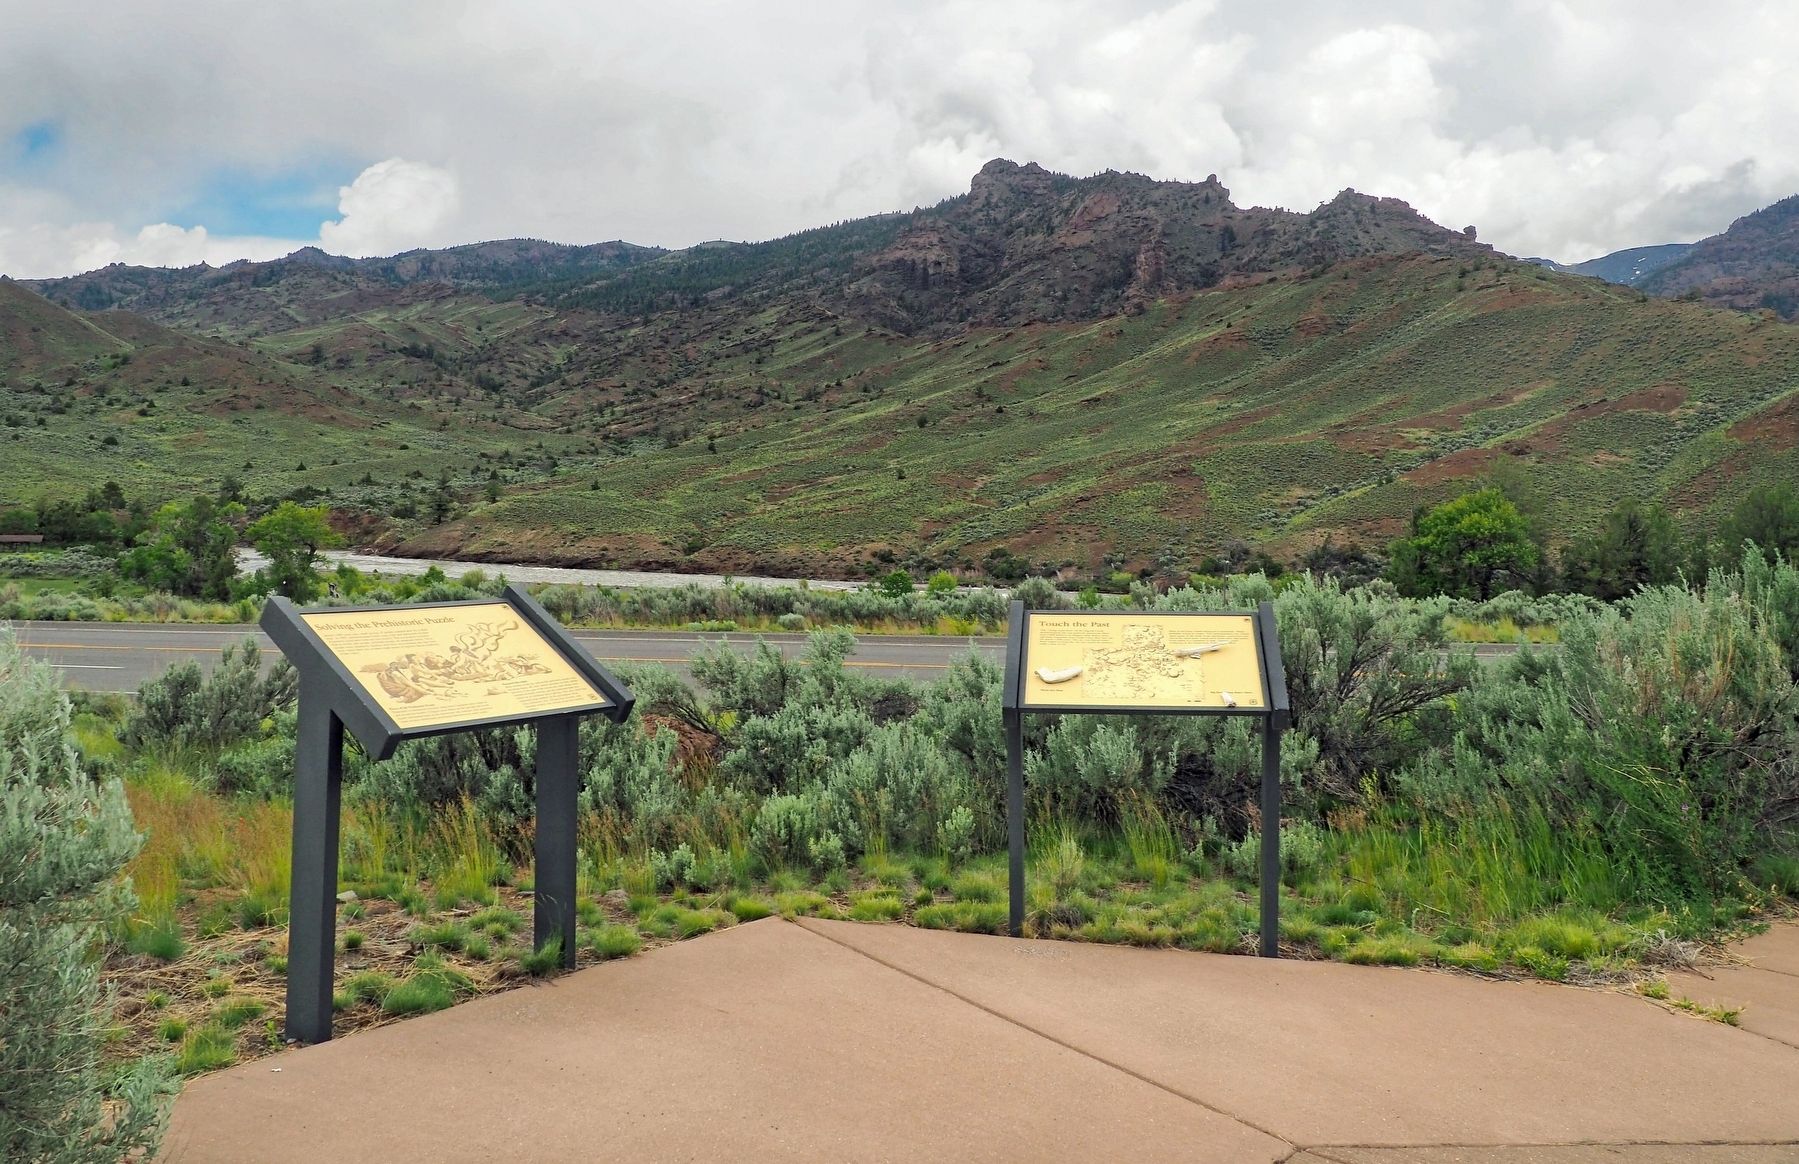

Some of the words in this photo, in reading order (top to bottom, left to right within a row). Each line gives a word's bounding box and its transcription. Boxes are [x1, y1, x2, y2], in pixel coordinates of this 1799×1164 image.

[314, 623, 354, 631] Solving
[354, 621, 371, 629] the
[371, 619, 424, 628] Prehistoric
[424, 617, 455, 625] Puzzle
[1039, 620, 1070, 628] Touch
[1072, 620, 1088, 628] the
